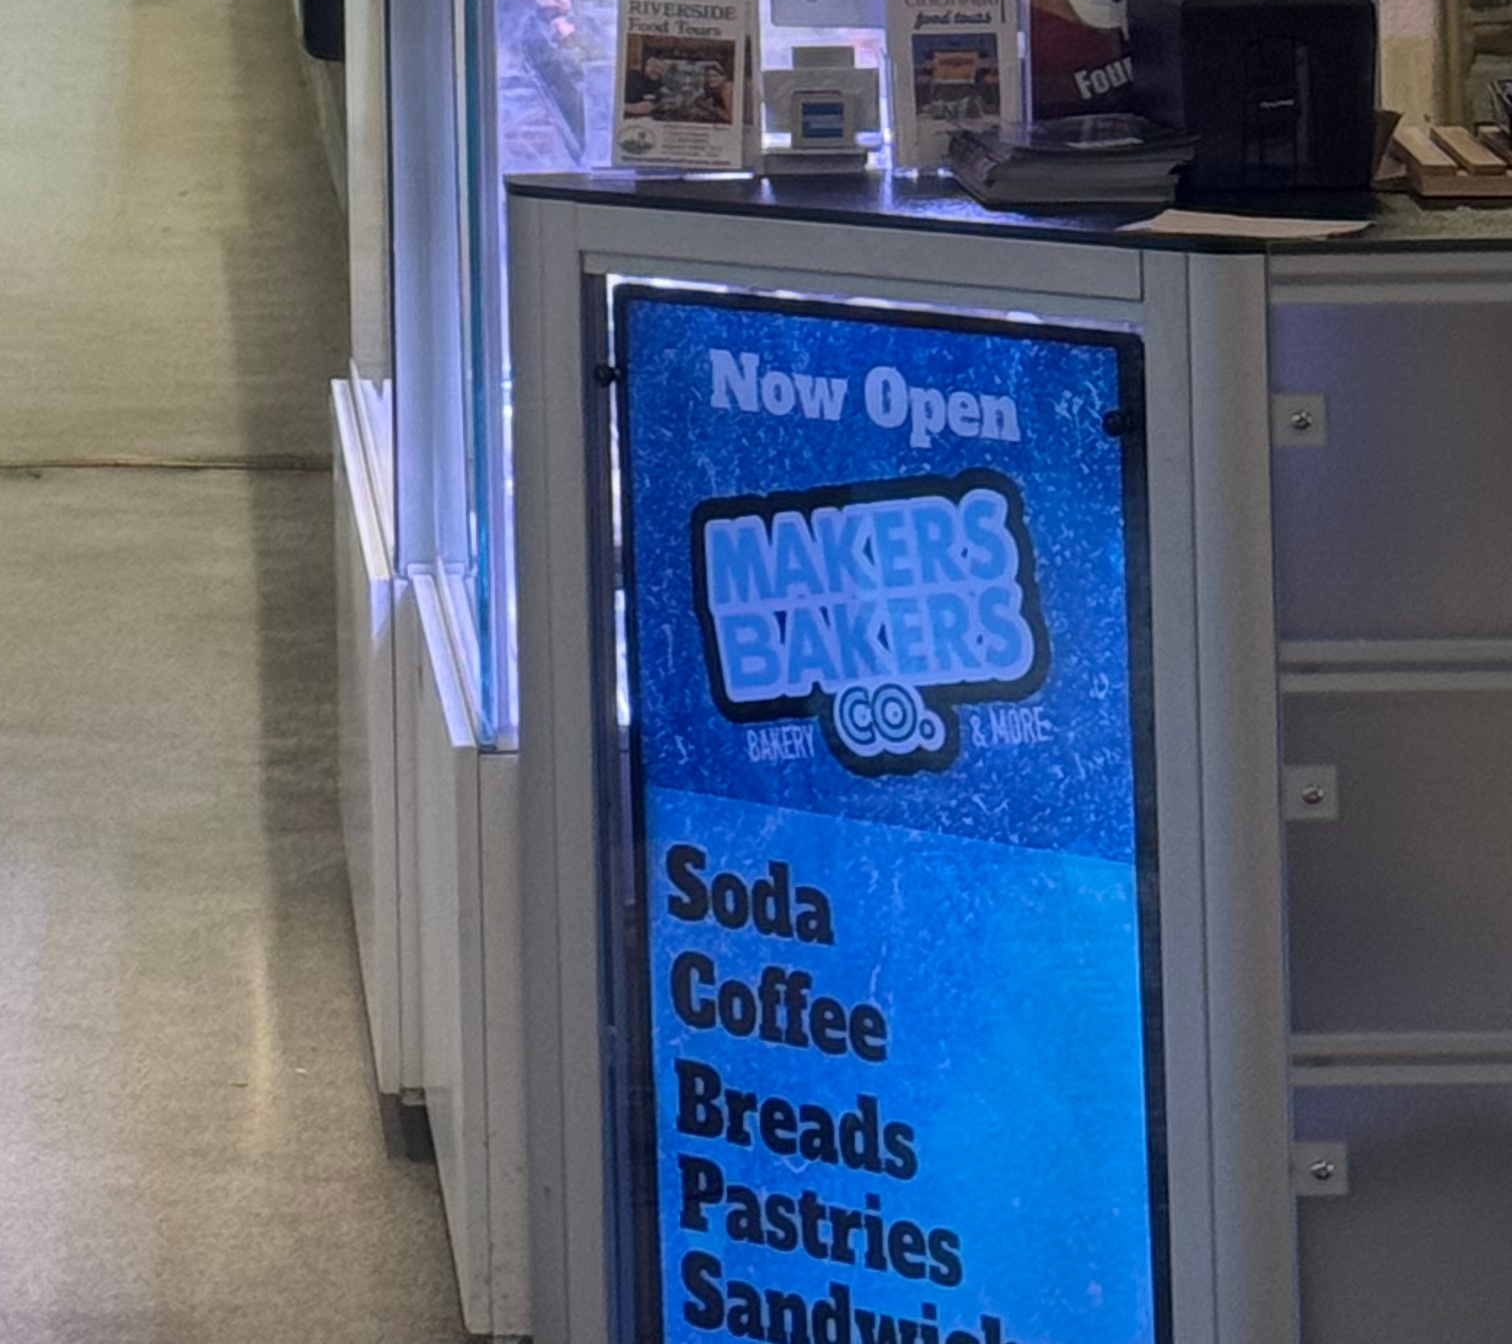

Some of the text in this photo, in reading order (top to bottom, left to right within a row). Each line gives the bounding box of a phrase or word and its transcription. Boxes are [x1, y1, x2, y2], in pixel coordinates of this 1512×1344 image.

[627, 0, 737, 21] RIVERSIDE
[627, 17, 723, 36] Food Tours
[708, 347, 1021, 449] Now Open
[705, 490, 1018, 608] MAKERS
[716, 588, 1031, 698] BAKERS
[747, 705, 1052, 762] BAKERY & MORE
[666, 843, 835, 946] Soda
[670, 949, 888, 1063] Coffee
[674, 1056, 918, 1181] Breads
[676, 1153, 964, 1288] Pastries
[680, 1249, 1020, 1344] Sandwi
